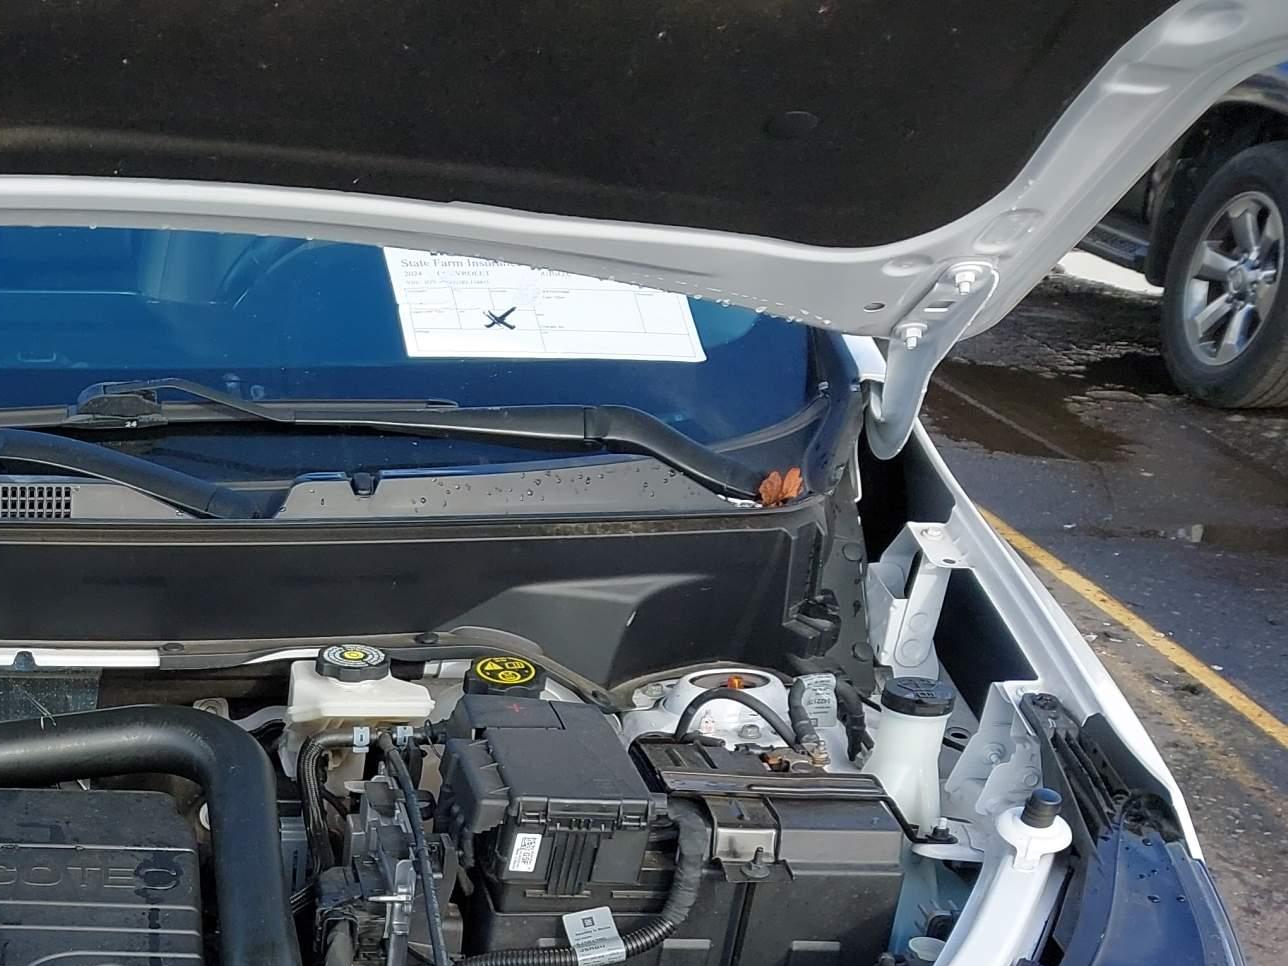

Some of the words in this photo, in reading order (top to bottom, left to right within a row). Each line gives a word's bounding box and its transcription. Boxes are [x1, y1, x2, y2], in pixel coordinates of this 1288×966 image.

[400, 258, 430, 268] State
[433, 259, 463, 268] Farm
[436, 270, 490, 278] CVROLET
